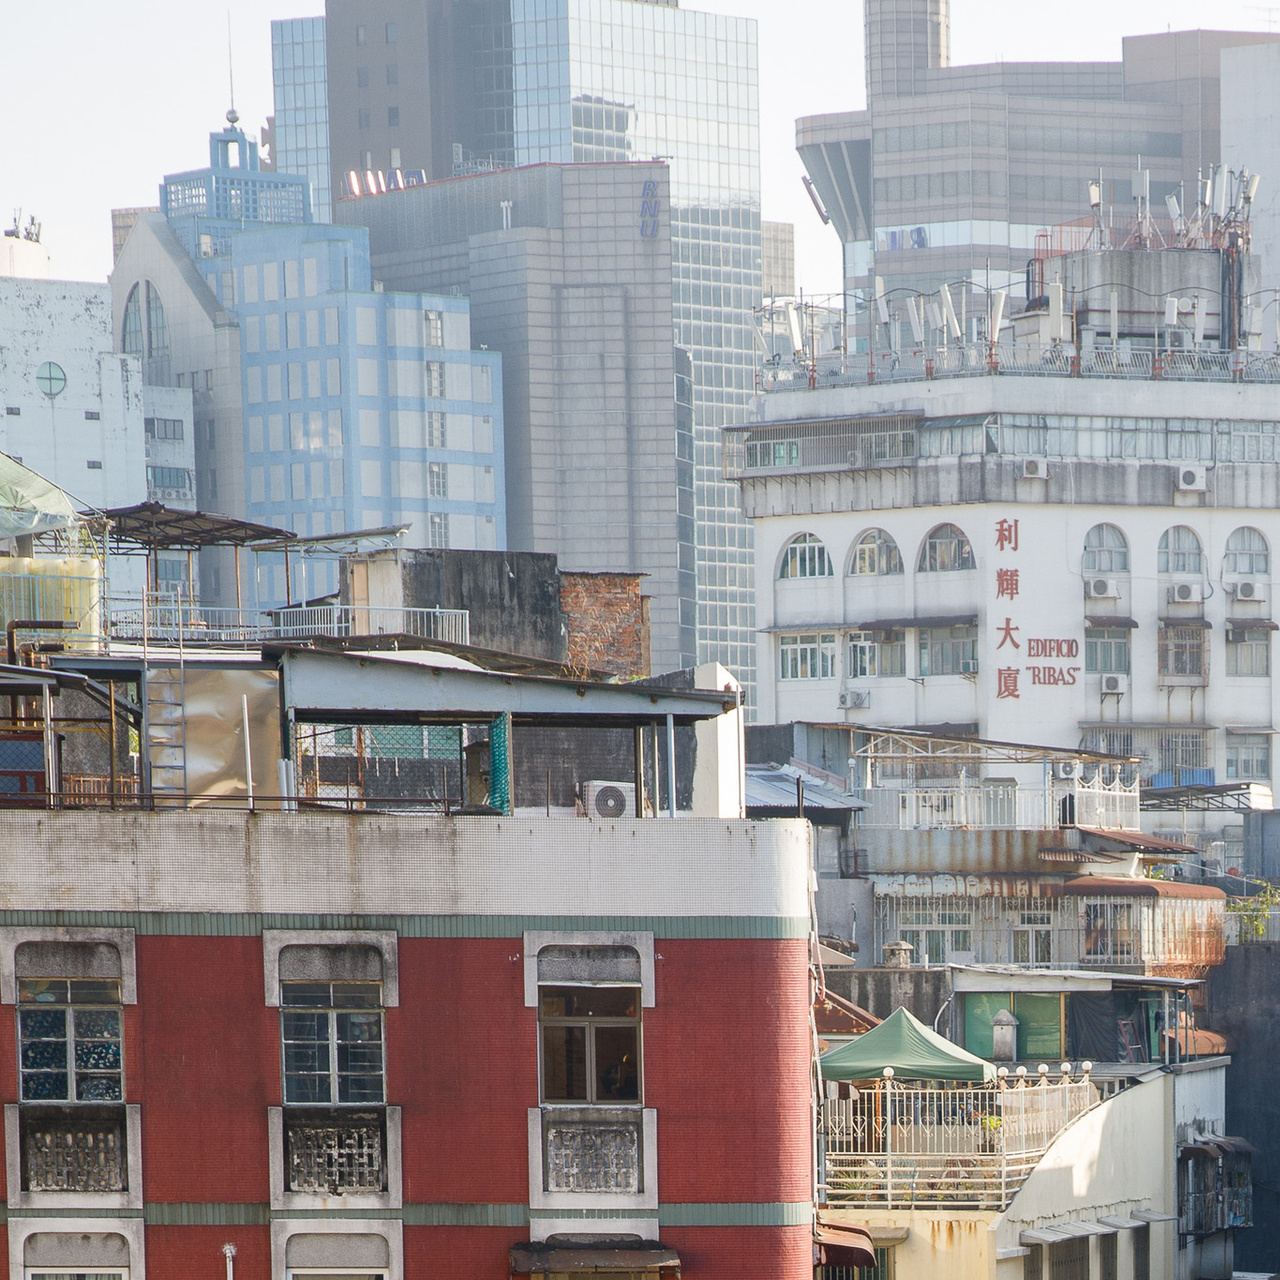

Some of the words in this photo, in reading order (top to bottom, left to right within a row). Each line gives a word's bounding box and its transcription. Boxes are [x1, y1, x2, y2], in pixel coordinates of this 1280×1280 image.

[995, 518, 1020, 699] 利輝大廈
[1028, 638, 1079, 658] EDIFICIO
[1025, 666, 1081, 686] "RIBAS"
